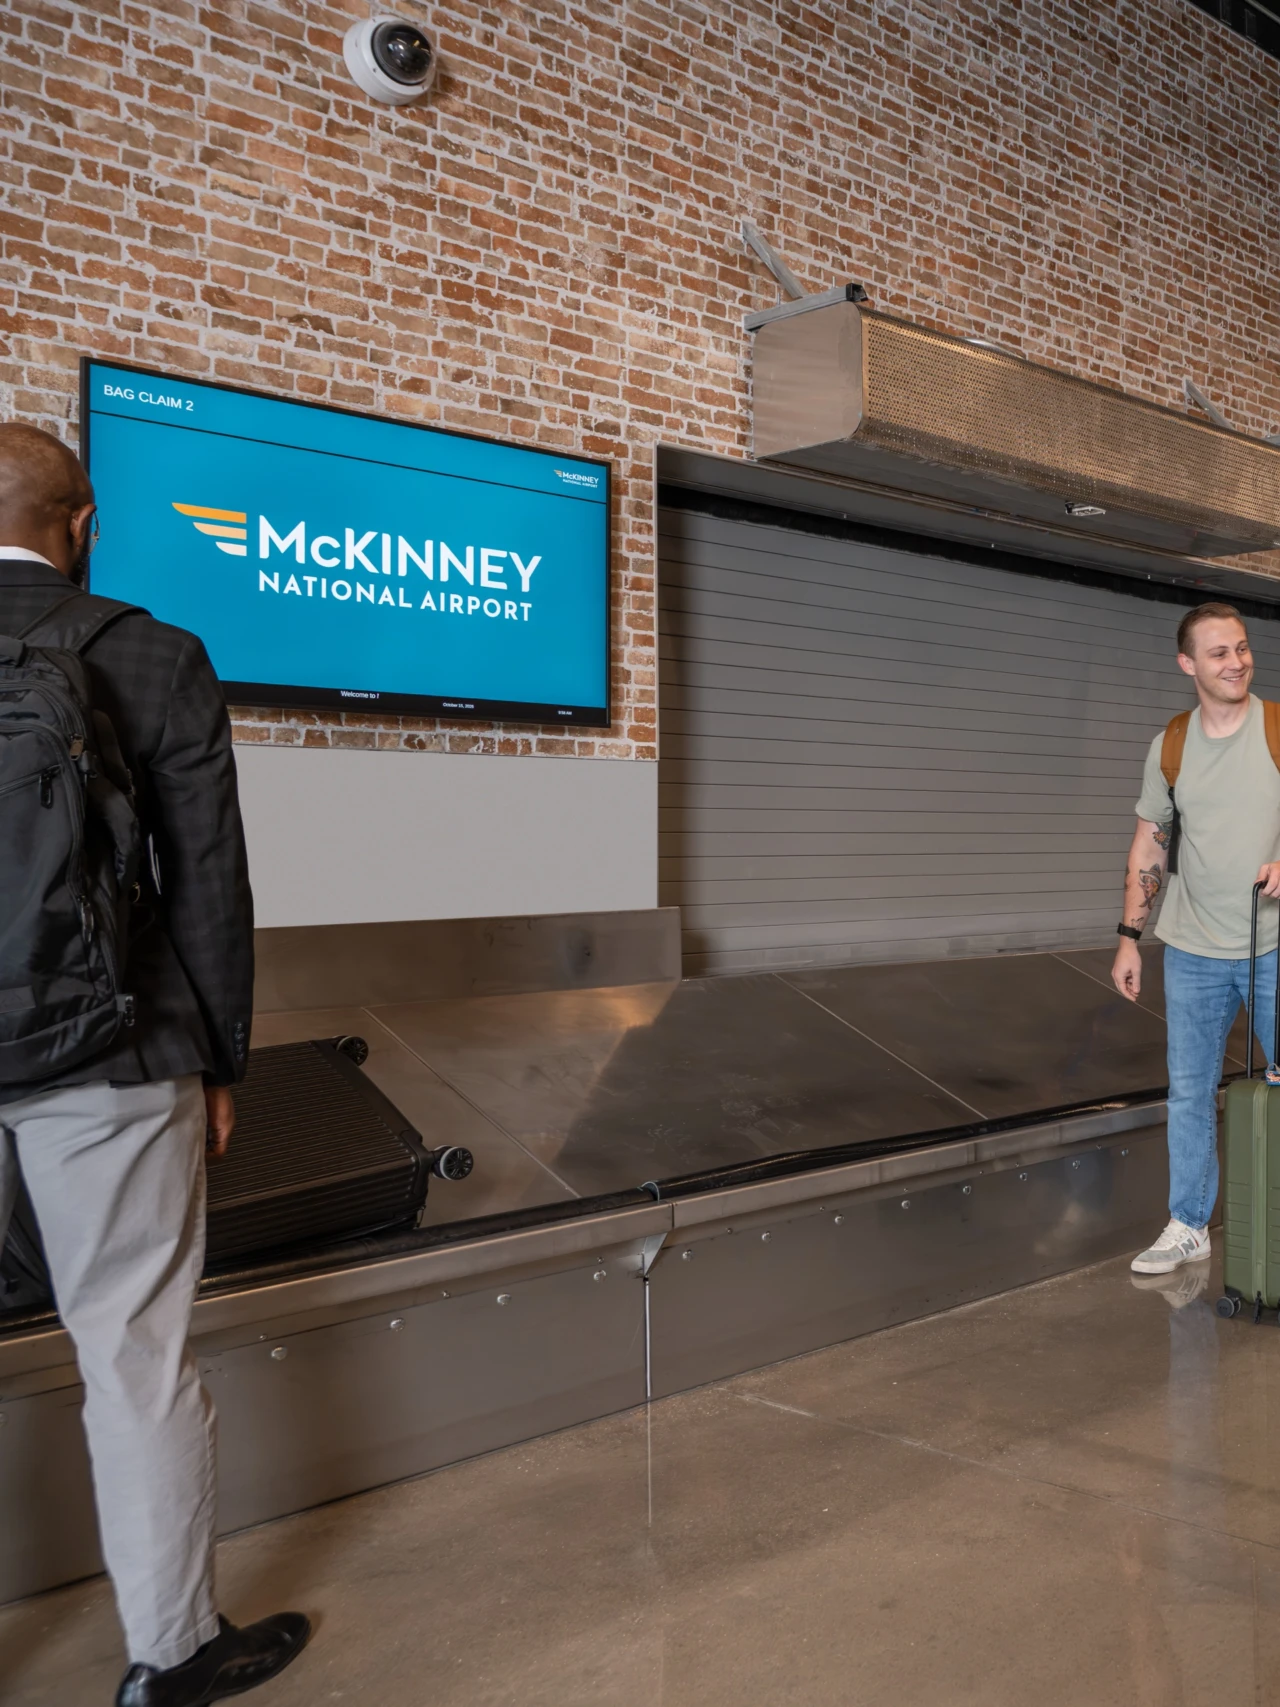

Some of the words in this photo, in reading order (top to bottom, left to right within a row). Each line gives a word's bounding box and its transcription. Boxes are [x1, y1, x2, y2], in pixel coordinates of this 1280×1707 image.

[104, 384, 134, 400] BAG
[138, 391, 182, 409] CLAIM
[185, 400, 194, 411] 2
[563, 472, 599, 484] McKINNEY
[259, 515, 542, 592] McKINNEY
[259, 570, 413, 608] NATIONAL
[420, 591, 532, 622] AIRPORT
[340, 690, 369, 699] Welcome
